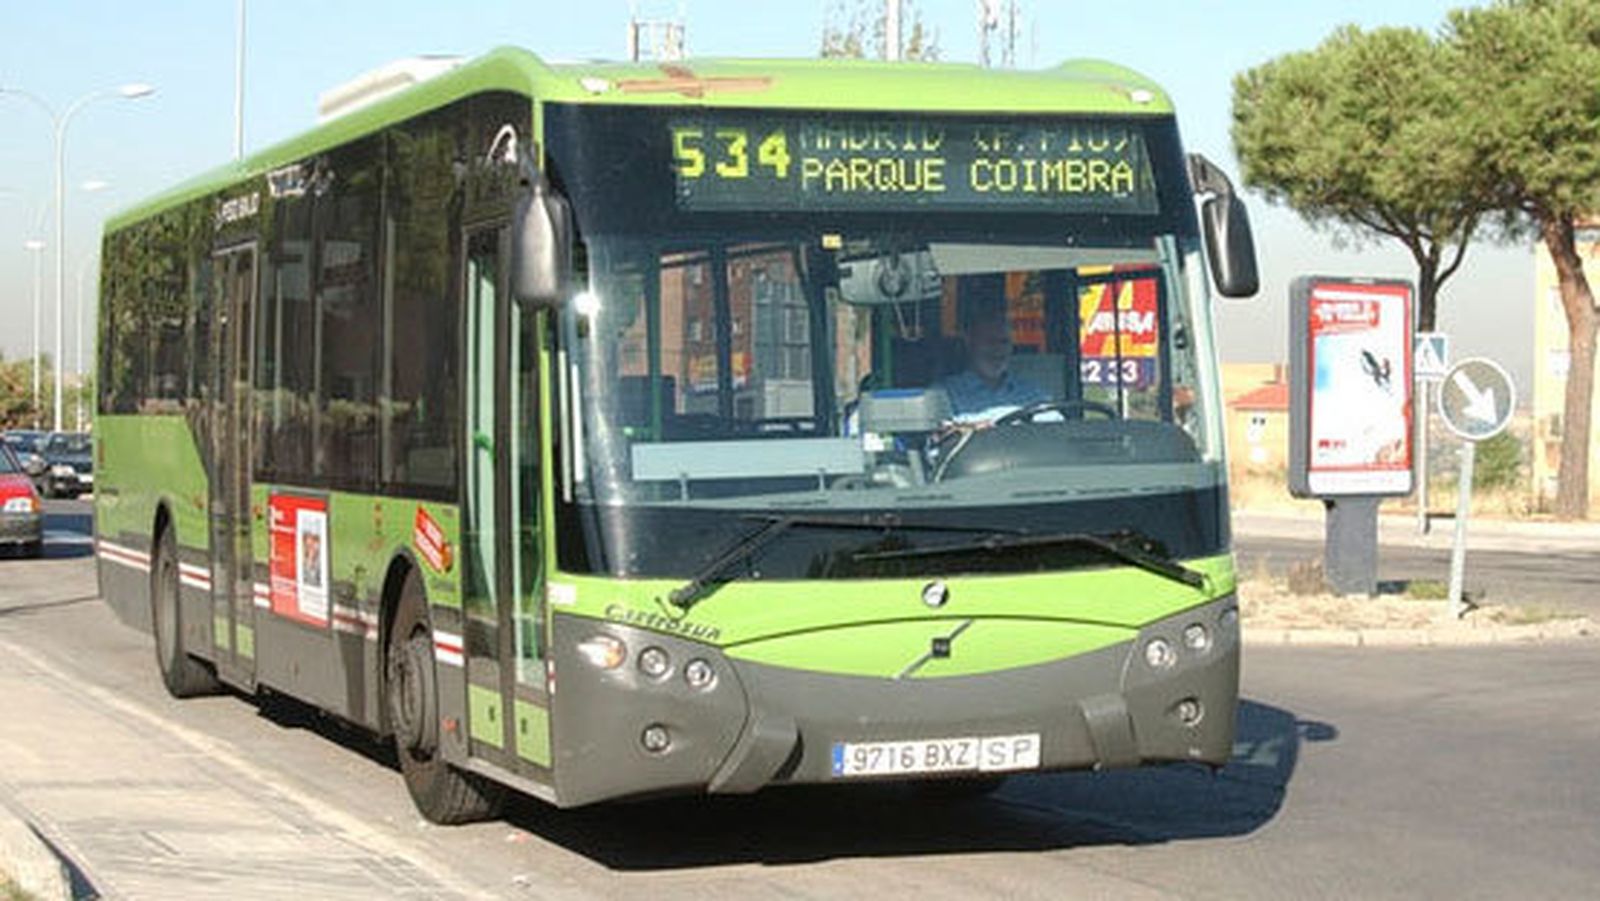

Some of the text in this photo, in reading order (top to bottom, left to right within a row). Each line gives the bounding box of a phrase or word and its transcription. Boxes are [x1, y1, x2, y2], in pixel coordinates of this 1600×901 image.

[672, 127, 791, 178] 534
[801, 158, 1134, 192] PARQUE COIMBRA
[853, 746, 915, 771] 9716
[924, 742, 971, 768] BXZ
